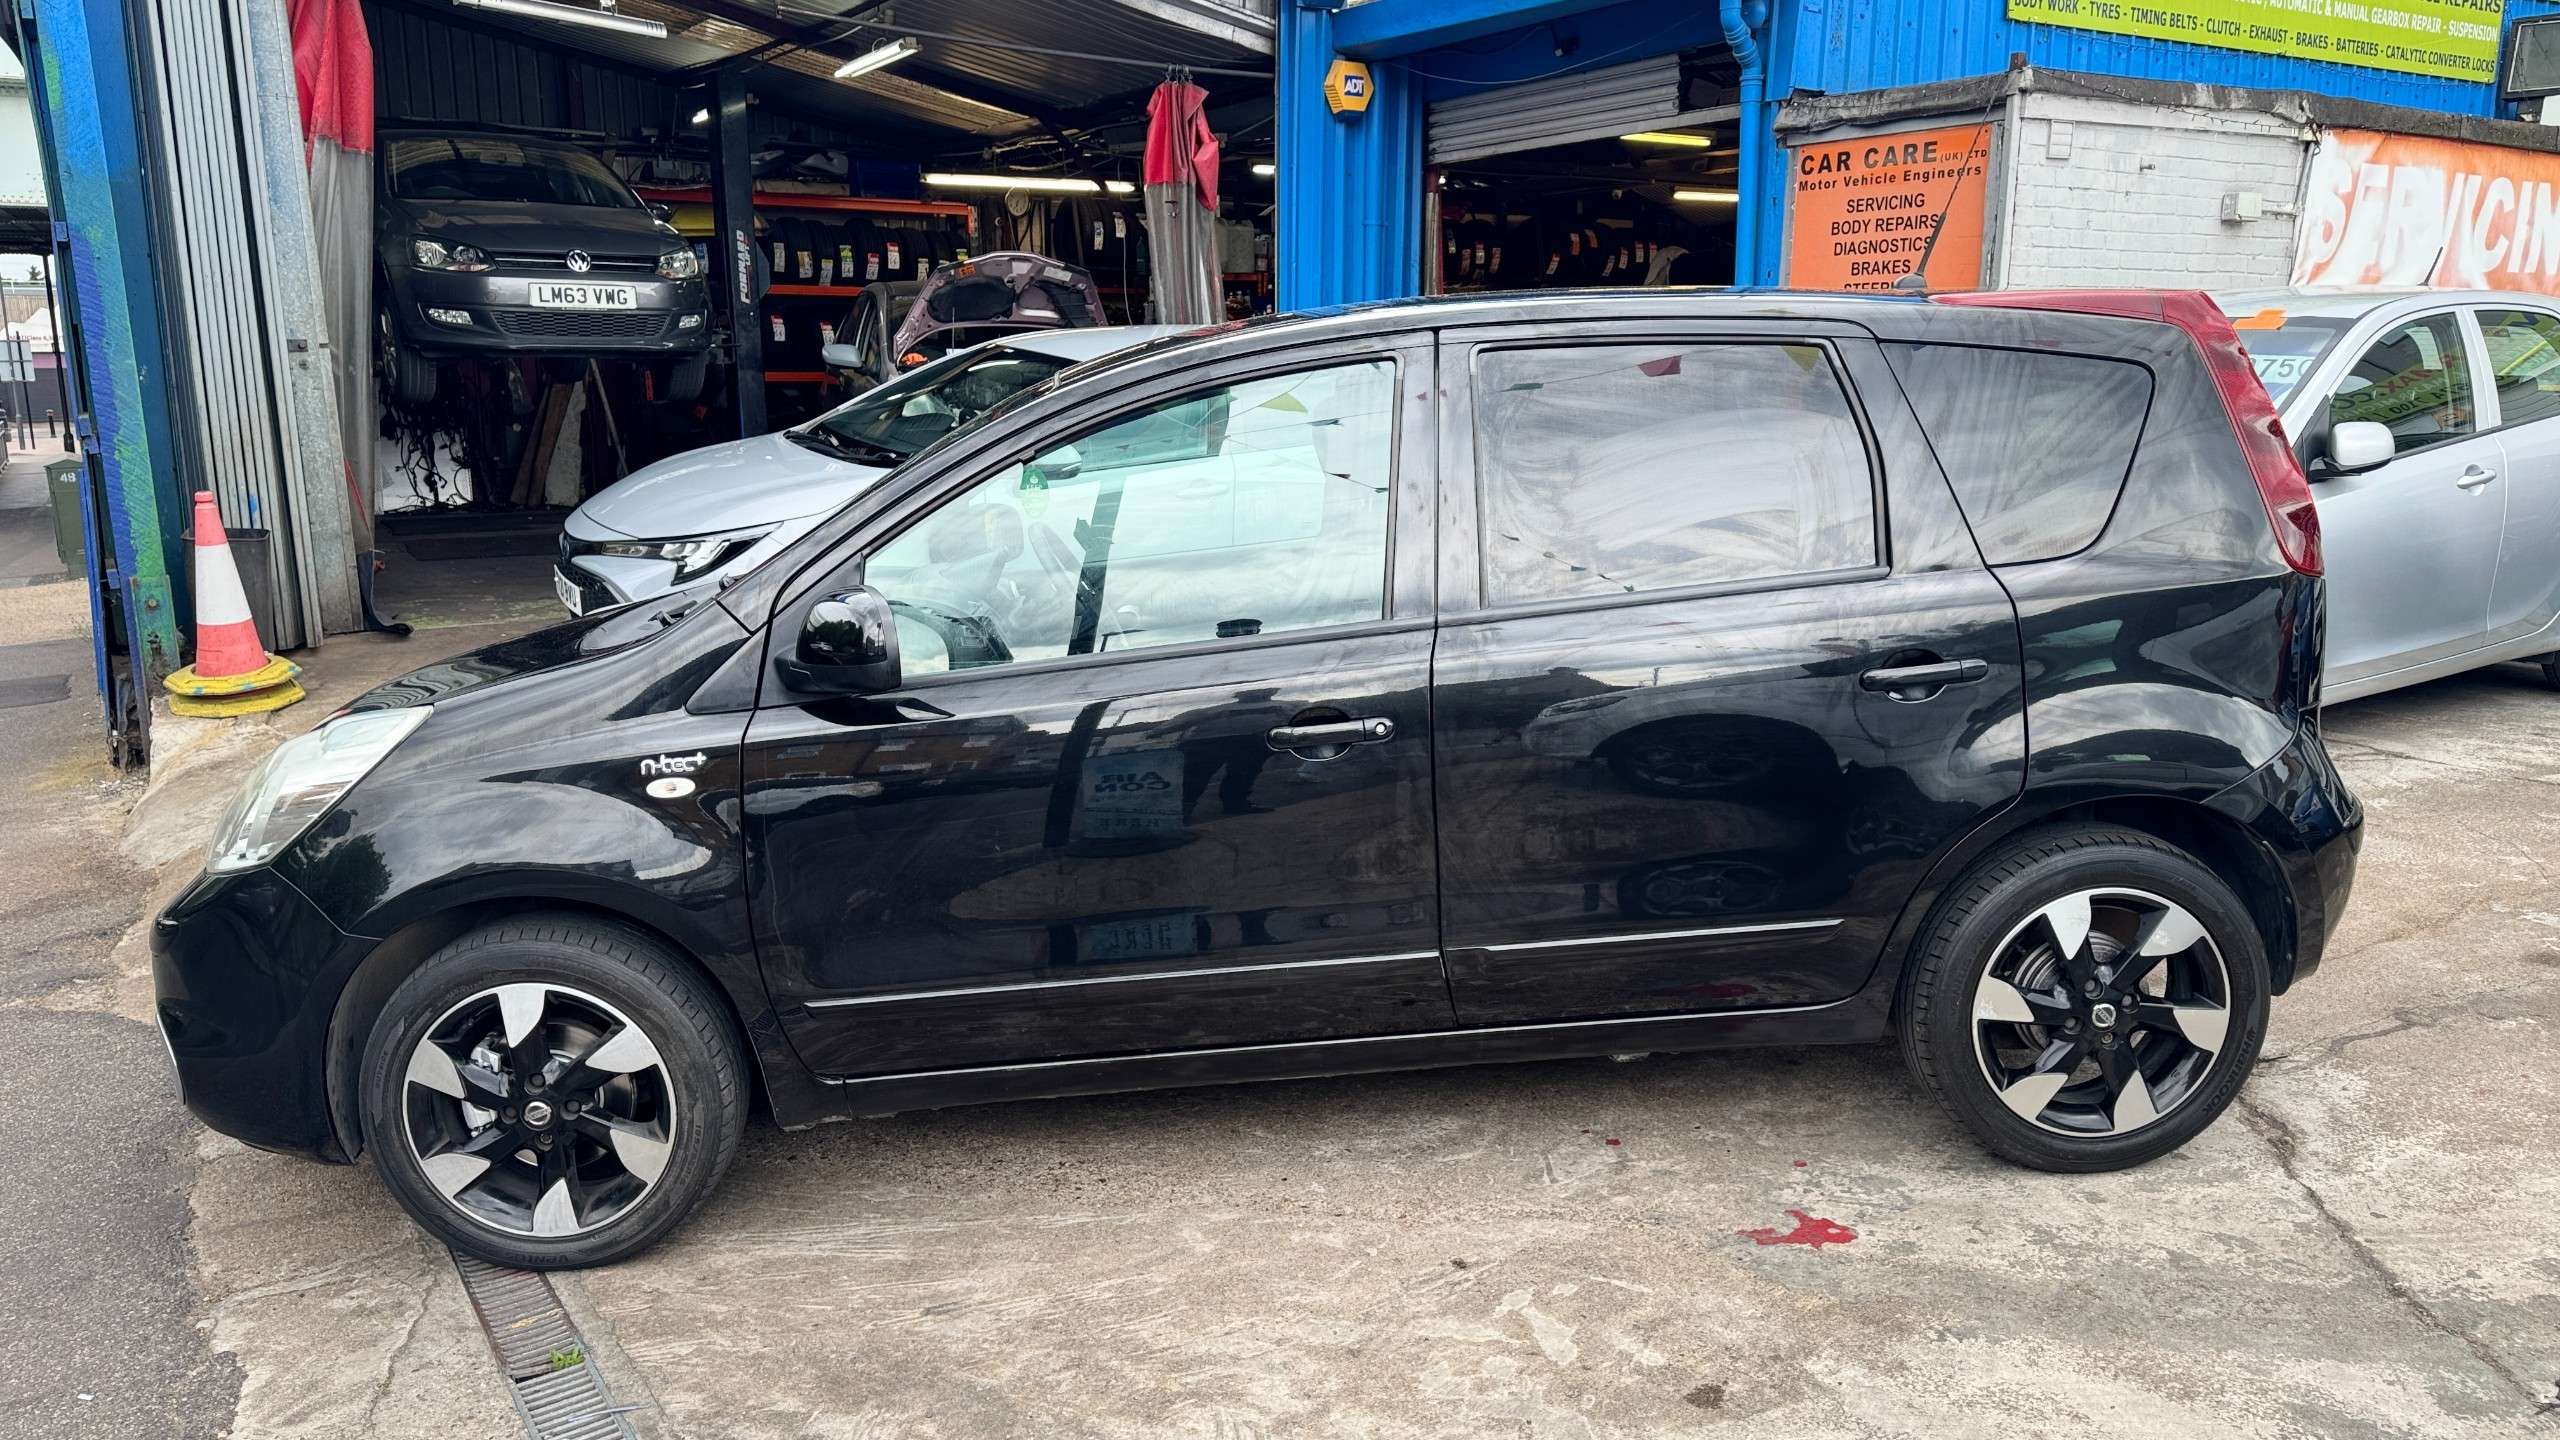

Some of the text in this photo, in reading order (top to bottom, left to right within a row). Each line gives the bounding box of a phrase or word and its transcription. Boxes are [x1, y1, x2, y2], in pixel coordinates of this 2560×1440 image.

[2333, 3, 2369, 23] MANUAL
[2371, 11, 2409, 29] GEARBOX
[2411, 17, 2441, 33] REPAIR
[2448, 20, 2497, 41] SUSPENSION
[2049, 0, 2078, 14] WORK
[2089, 2, 2120, 20] TYRES
[2130, 7, 2167, 26] TIMING
[2170, 13, 2198, 31] BELTS
[2206, 18, 2241, 37] CLUTCH
[2249, 25, 2288, 44] EXHAUST
[2296, 32, 2328, 49] BRAKES
[2336, 38, 2378, 57] BATTERIES
[2385, 45, 2426, 64] CATALYTIC
[2428, 50, 2470, 69] CONVERTER
[2472, 58, 2495, 73] LOCKS
[1344, 79, 1364, 94] ADT
[1801, 151, 1851, 175] CAR
[1864, 141, 1938, 168] CARE
[1940, 152, 1963, 163] (UK)
[1799, 166, 1982, 192] Motor Vehicle Engineers
[1846, 193, 1925, 213] SERVICING
[1831, 213, 1939, 236] BODY REPAIRS
[1834, 236, 1933, 256] DIAGNOSTICS
[736, 230, 751, 304] FORWARD
[1851, 259, 1911, 276] BRAKES
[538, 286, 628, 305] LM63 VWG
[2250, 357, 2314, 378] 75
